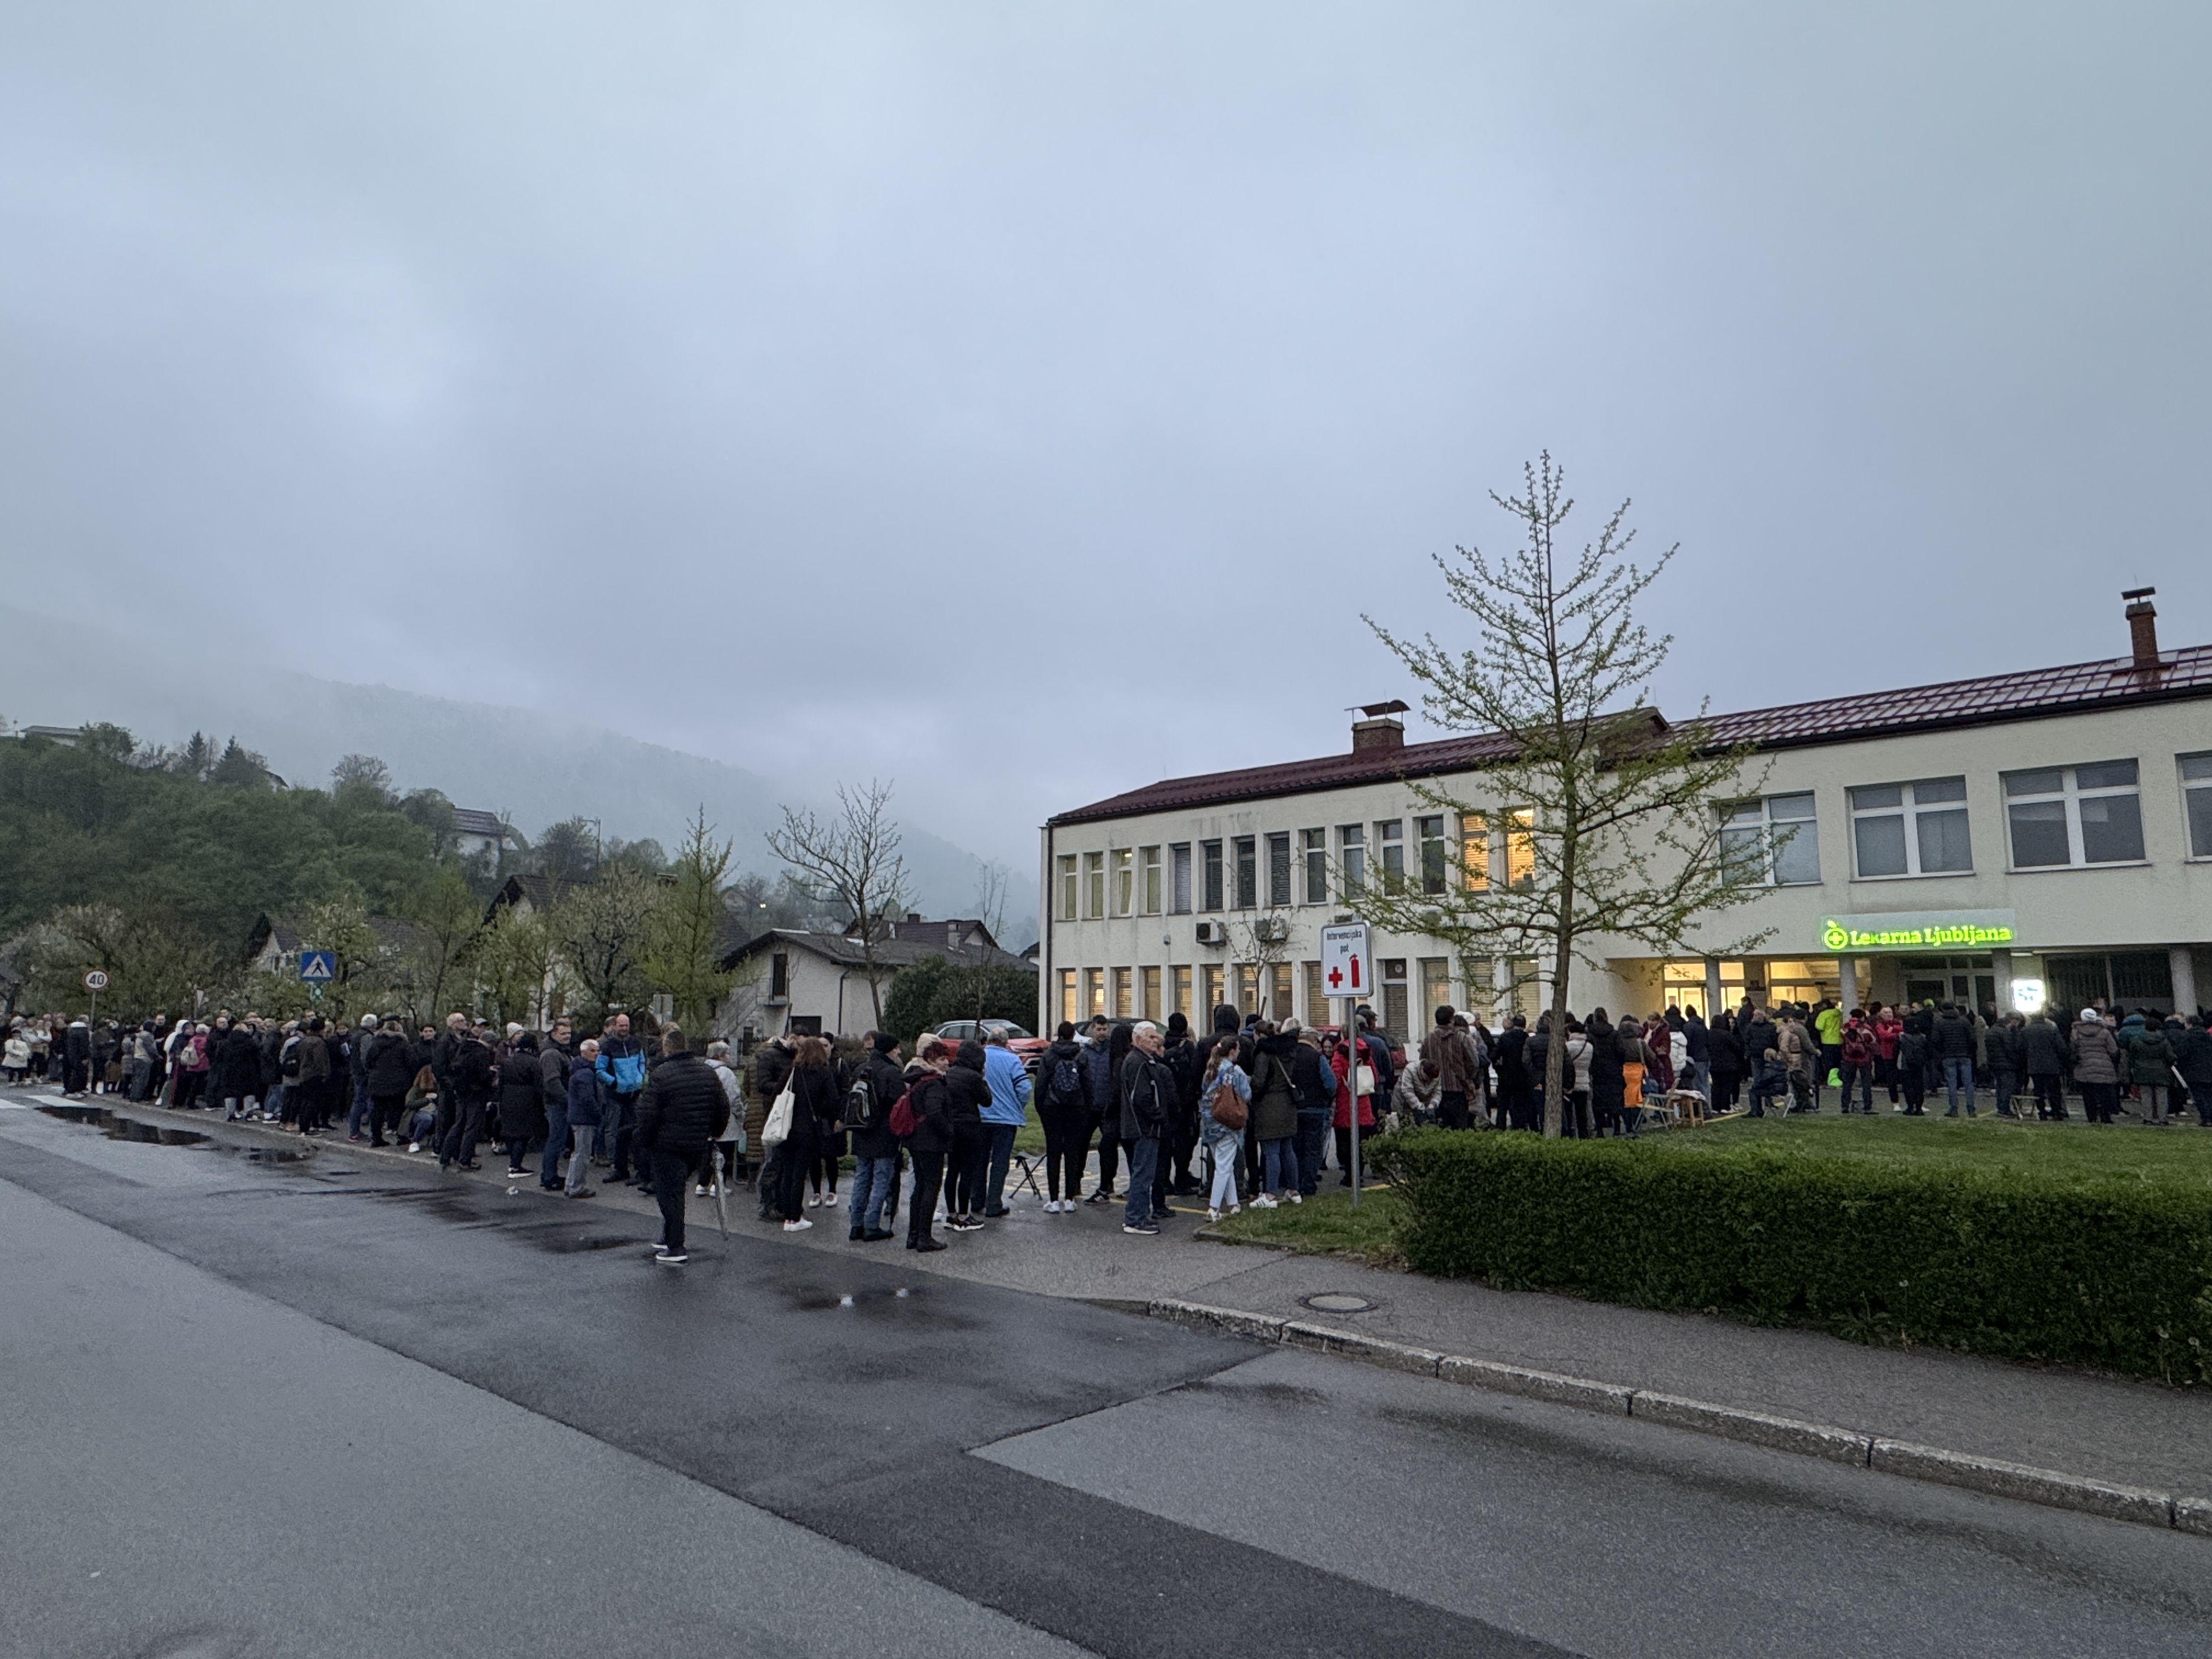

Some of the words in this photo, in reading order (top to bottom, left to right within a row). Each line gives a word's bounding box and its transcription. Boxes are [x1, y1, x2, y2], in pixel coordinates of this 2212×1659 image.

[1850, 930, 1922, 945] Lekarna
[1924, 924, 2012, 946] Ljubljana
[89, 974, 105, 985] 40
